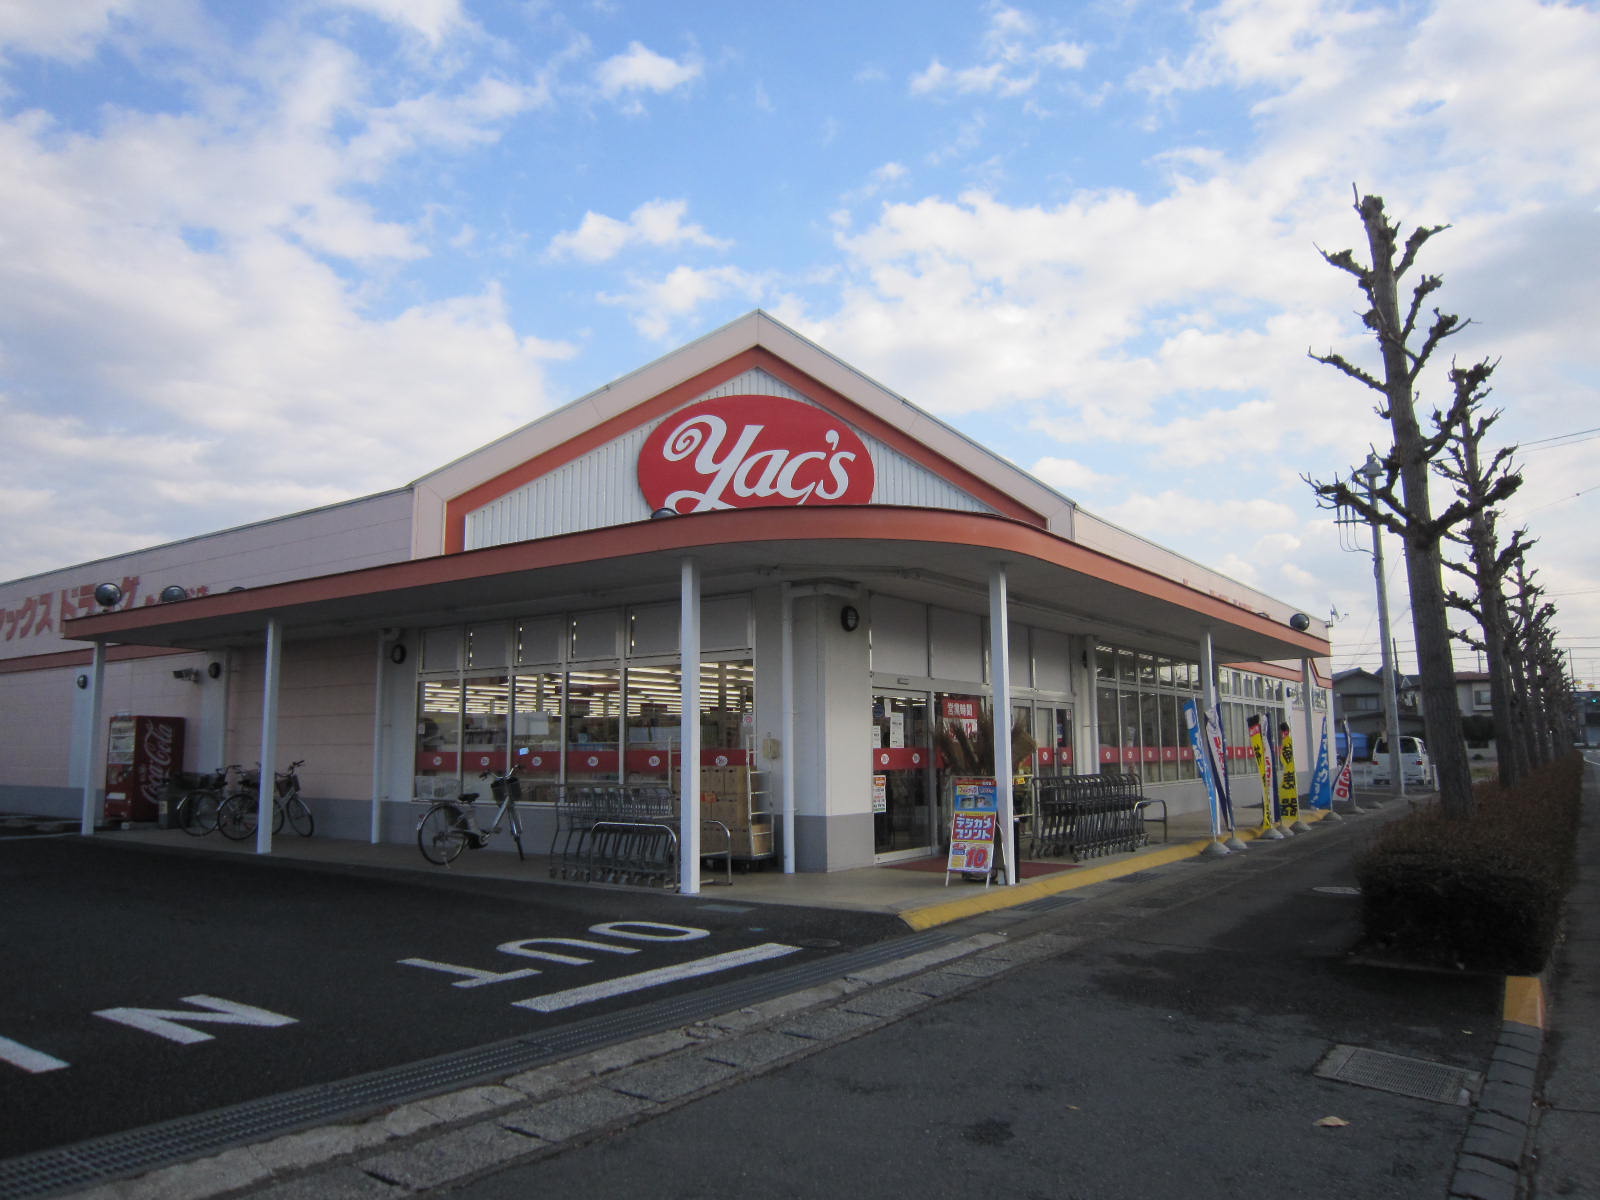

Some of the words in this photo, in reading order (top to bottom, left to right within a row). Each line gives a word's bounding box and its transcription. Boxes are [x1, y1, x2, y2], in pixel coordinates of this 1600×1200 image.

[662, 414, 856, 514] Yac's
[956, 816, 993, 829] デジカメ
[396, 920, 711, 988] OUT
